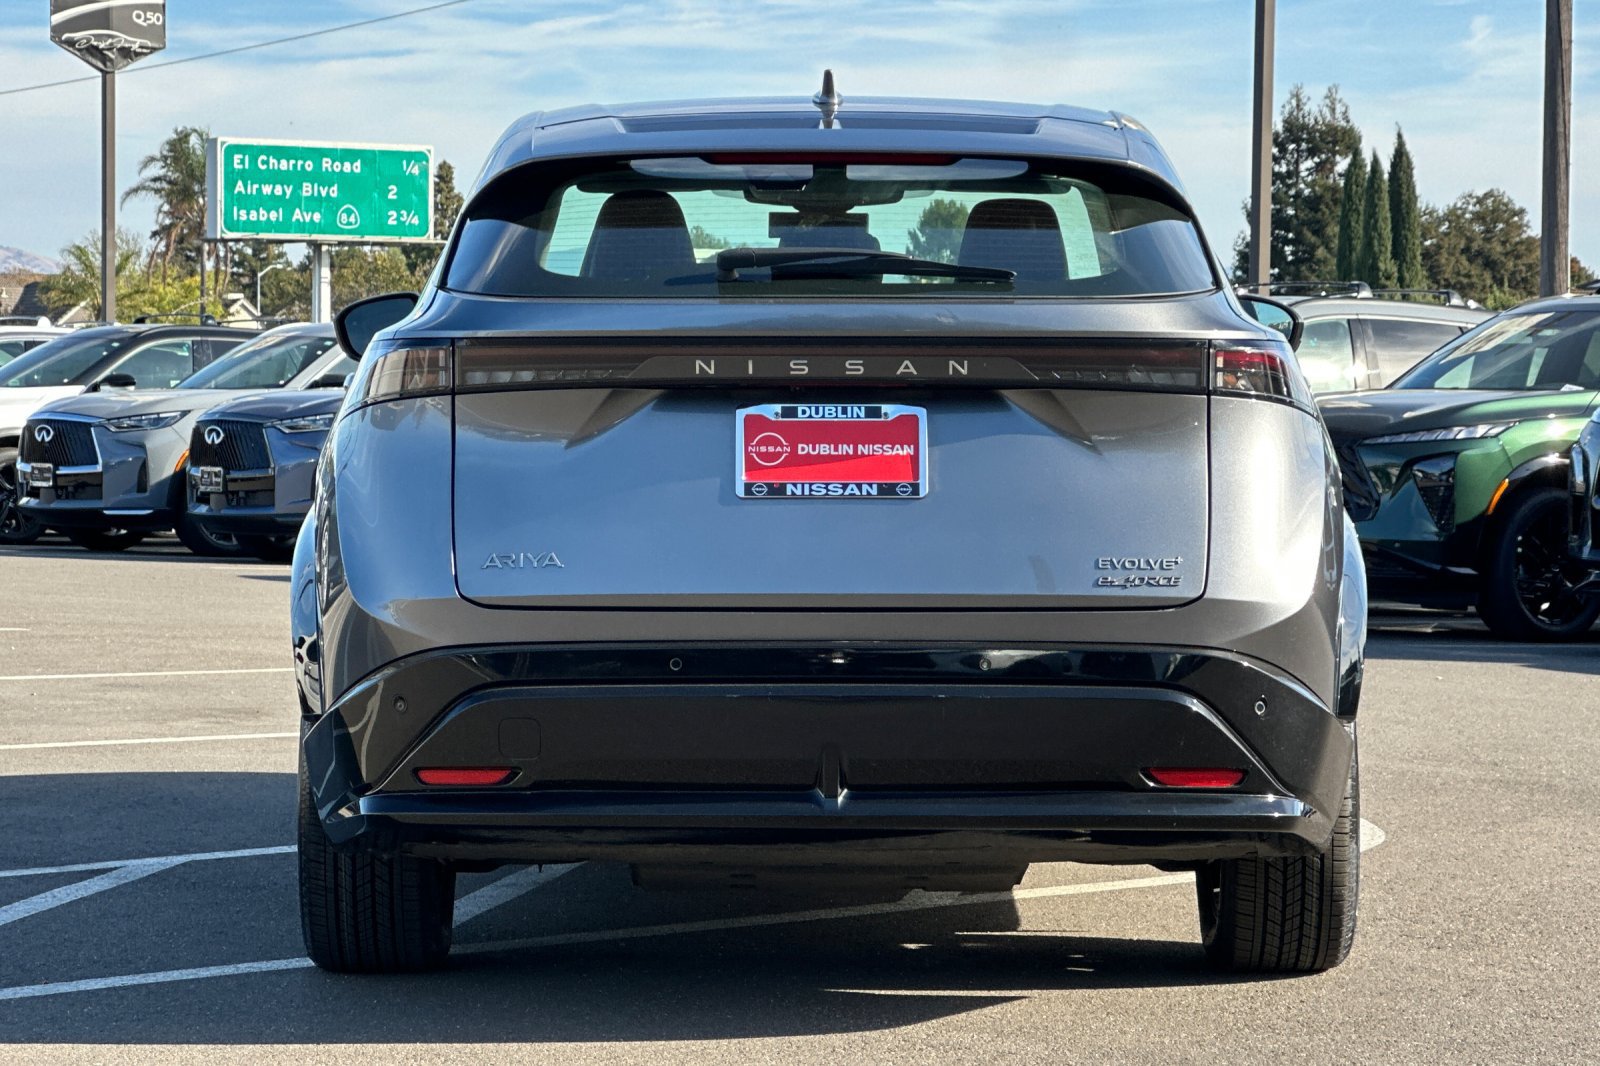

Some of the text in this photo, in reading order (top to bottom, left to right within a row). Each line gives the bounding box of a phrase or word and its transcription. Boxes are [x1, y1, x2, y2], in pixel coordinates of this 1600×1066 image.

[132, 10, 162, 27] Q50
[233, 154, 249, 169] El
[257, 155, 313, 171] Charro
[322, 158, 361, 173] Road
[234, 180, 398, 199] Airway Blvd 2
[233, 206, 283, 222] Isabel
[292, 208, 322, 223] Ave
[340, 212, 356, 224] 84
[695, 359, 968, 375] NISSAN
[797, 406, 865, 418] DUBLIN
[748, 445, 790, 453] NISSAN
[797, 443, 914, 456] DUBLIN NISSAN
[786, 483, 878, 496] NISSAN
[481, 552, 564, 568] ARIYA
